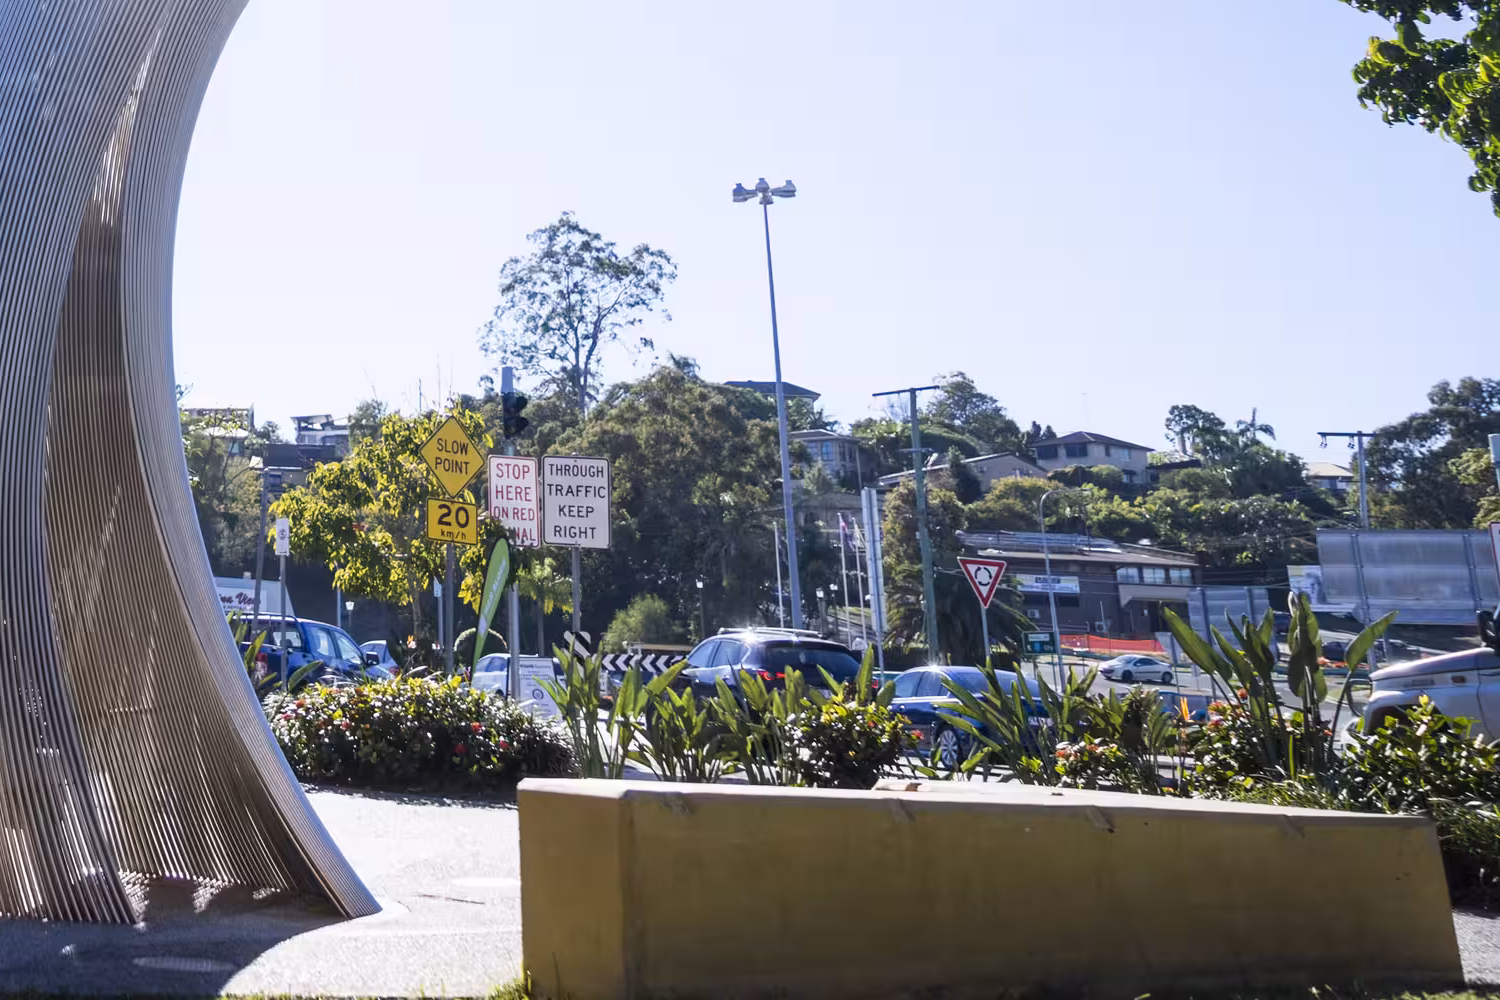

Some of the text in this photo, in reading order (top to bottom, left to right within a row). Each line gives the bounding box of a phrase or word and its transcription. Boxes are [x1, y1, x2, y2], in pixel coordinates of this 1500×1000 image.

[436, 438, 469, 456] SLOW
[435, 457, 470, 475] POINT
[496, 463, 530, 480] STOP
[548, 463, 604, 478] THROUGH
[495, 484, 532, 502] HERE
[547, 484, 606, 499] TRAFFIC
[437, 503, 470, 529] 20
[493, 506, 535, 521] ON RED
[558, 504, 595, 519] KEEP
[440, 528, 467, 540] km/h
[553, 525, 597, 540] RIGHT
